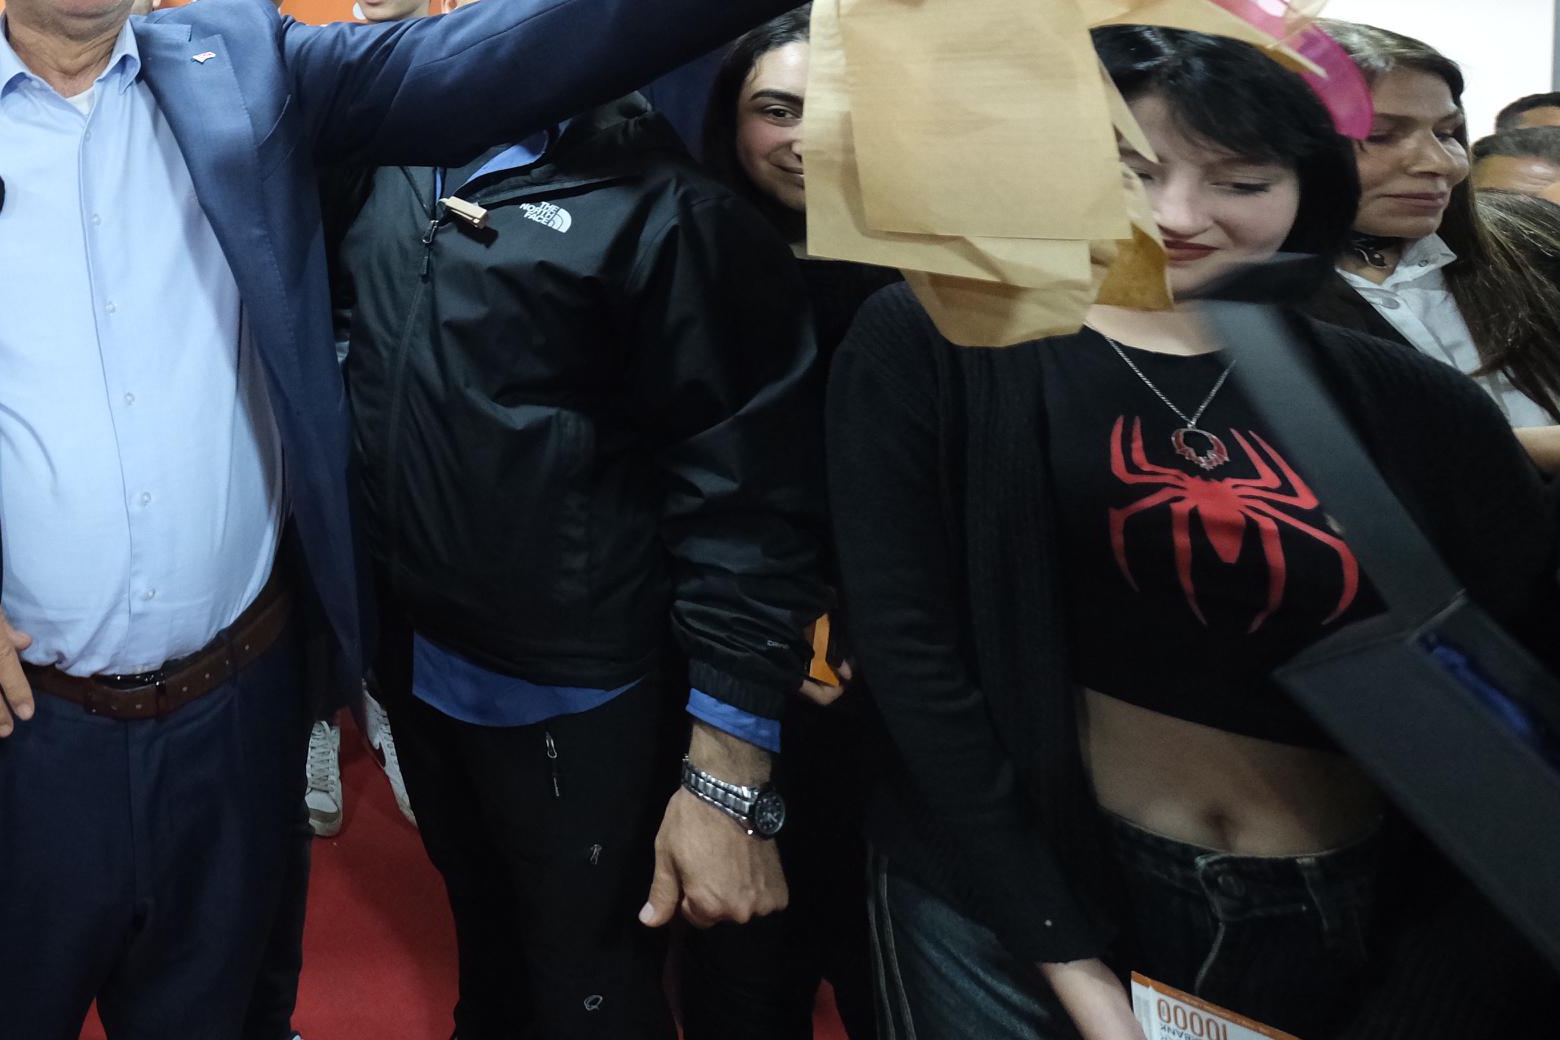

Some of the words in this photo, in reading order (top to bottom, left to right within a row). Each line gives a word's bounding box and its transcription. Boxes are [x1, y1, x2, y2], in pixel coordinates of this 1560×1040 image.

[519, 203, 556, 220] NORTH
[541, 201, 560, 213] THE
[524, 211, 549, 226] FACE
